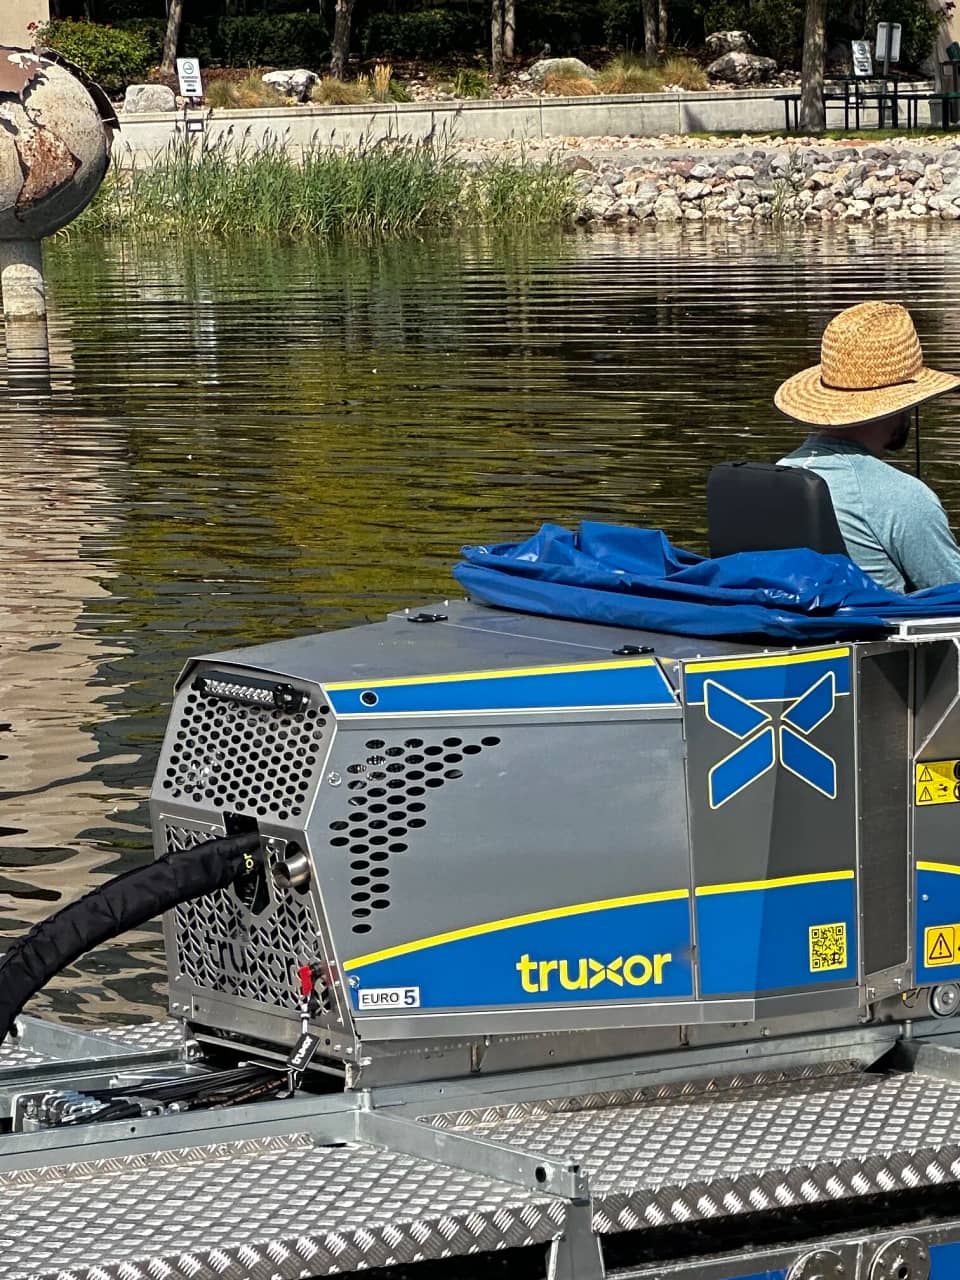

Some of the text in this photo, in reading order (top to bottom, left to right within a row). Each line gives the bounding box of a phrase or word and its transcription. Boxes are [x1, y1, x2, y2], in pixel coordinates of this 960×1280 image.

[204, 930, 296, 985] truxor
[516, 953, 672, 993] truxor
[361, 989, 416, 1006] EURO 5
[291, 1035, 313, 1065] truxor
